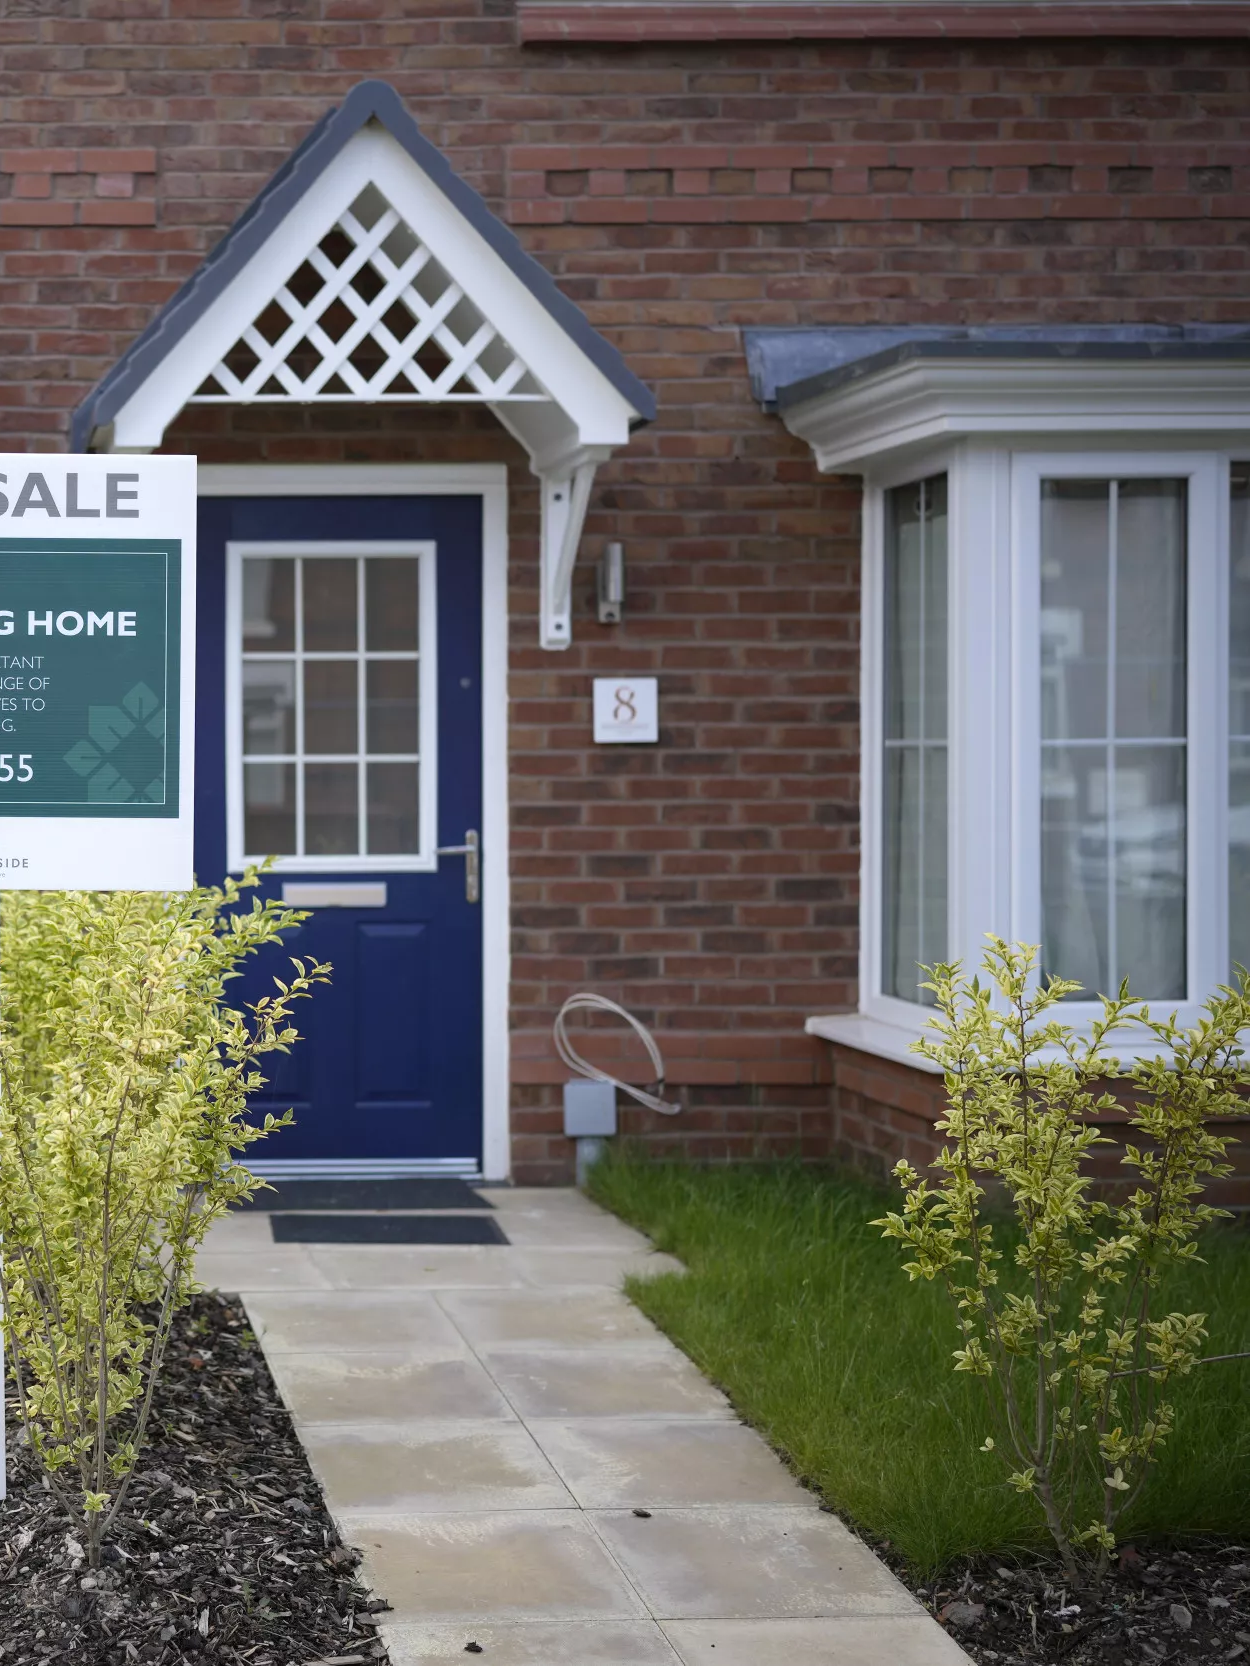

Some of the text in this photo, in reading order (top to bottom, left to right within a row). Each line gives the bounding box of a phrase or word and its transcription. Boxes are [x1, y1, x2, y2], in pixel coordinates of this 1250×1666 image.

[27, 610, 137, 637] HOME
[28, 676, 51, 691] OF
[21, 697, 46, 712] TO
[612, 685, 637, 723] 8
